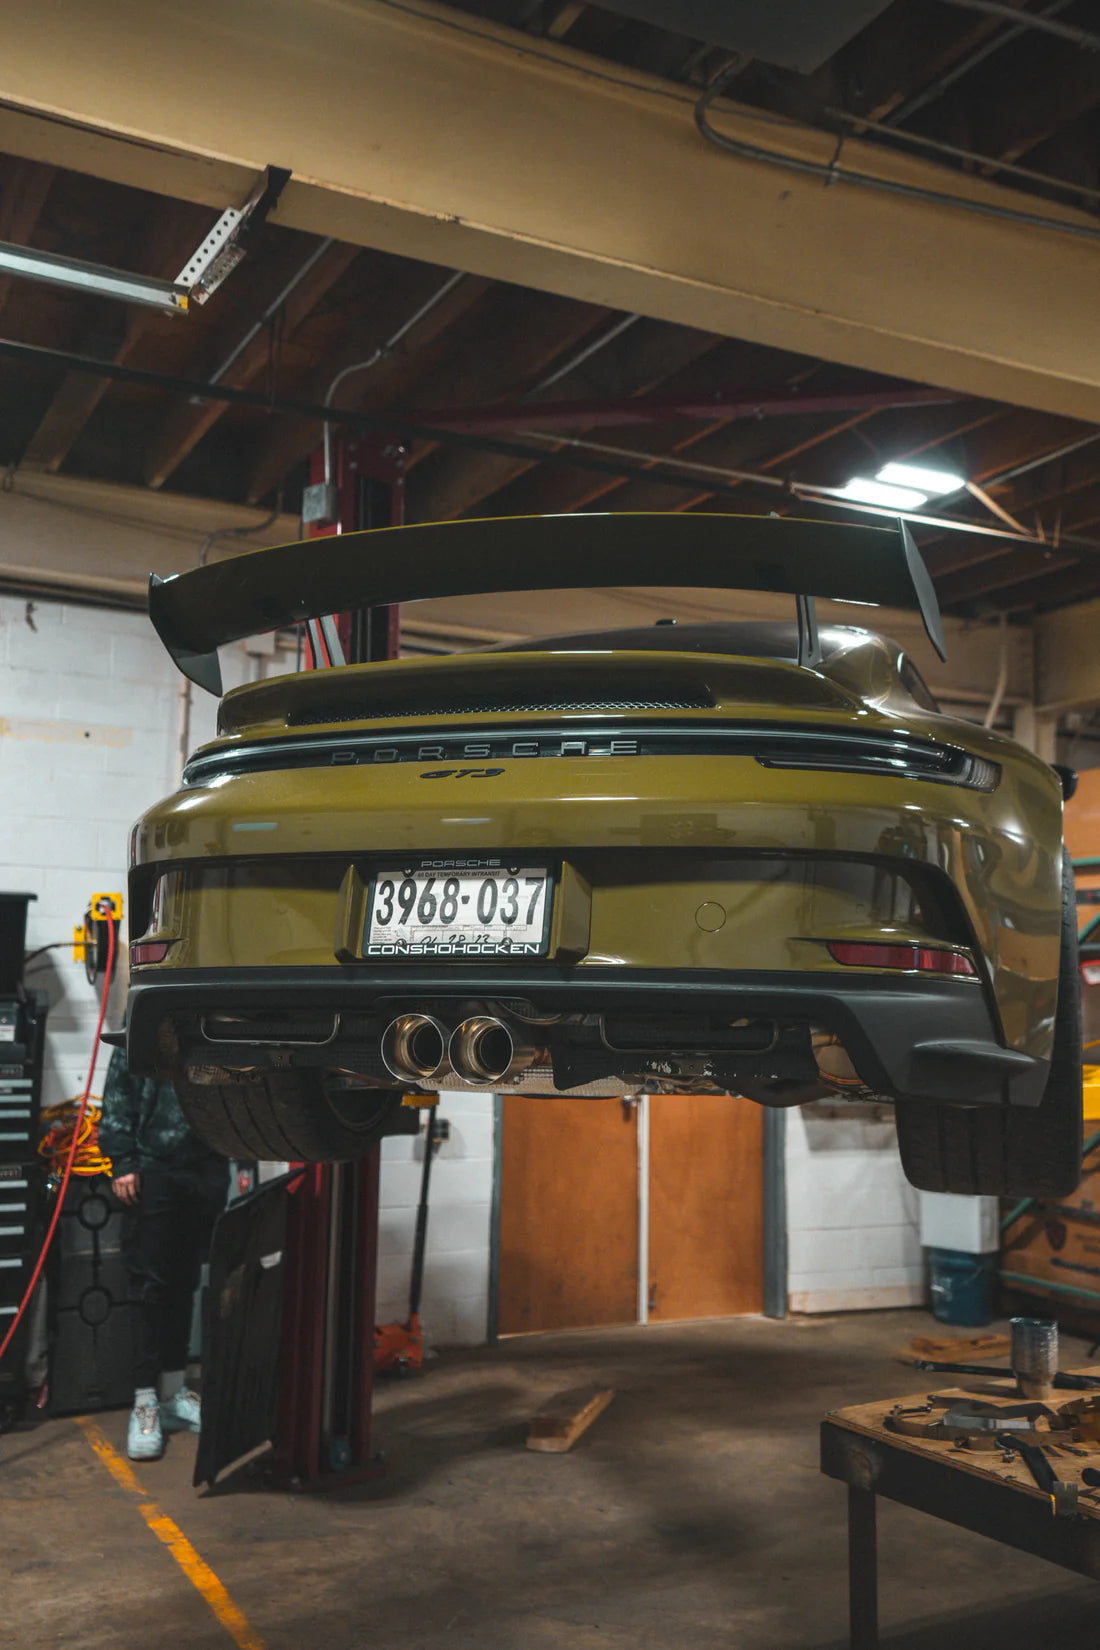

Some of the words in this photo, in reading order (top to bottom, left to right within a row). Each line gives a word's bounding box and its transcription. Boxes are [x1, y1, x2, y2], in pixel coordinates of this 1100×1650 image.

[331, 741, 638, 764] PORSCHE
[419, 767, 506, 779] GT3
[421, 860, 501, 868] PORSCHE
[368, 944, 539, 954] CONSHOHOCKEN
